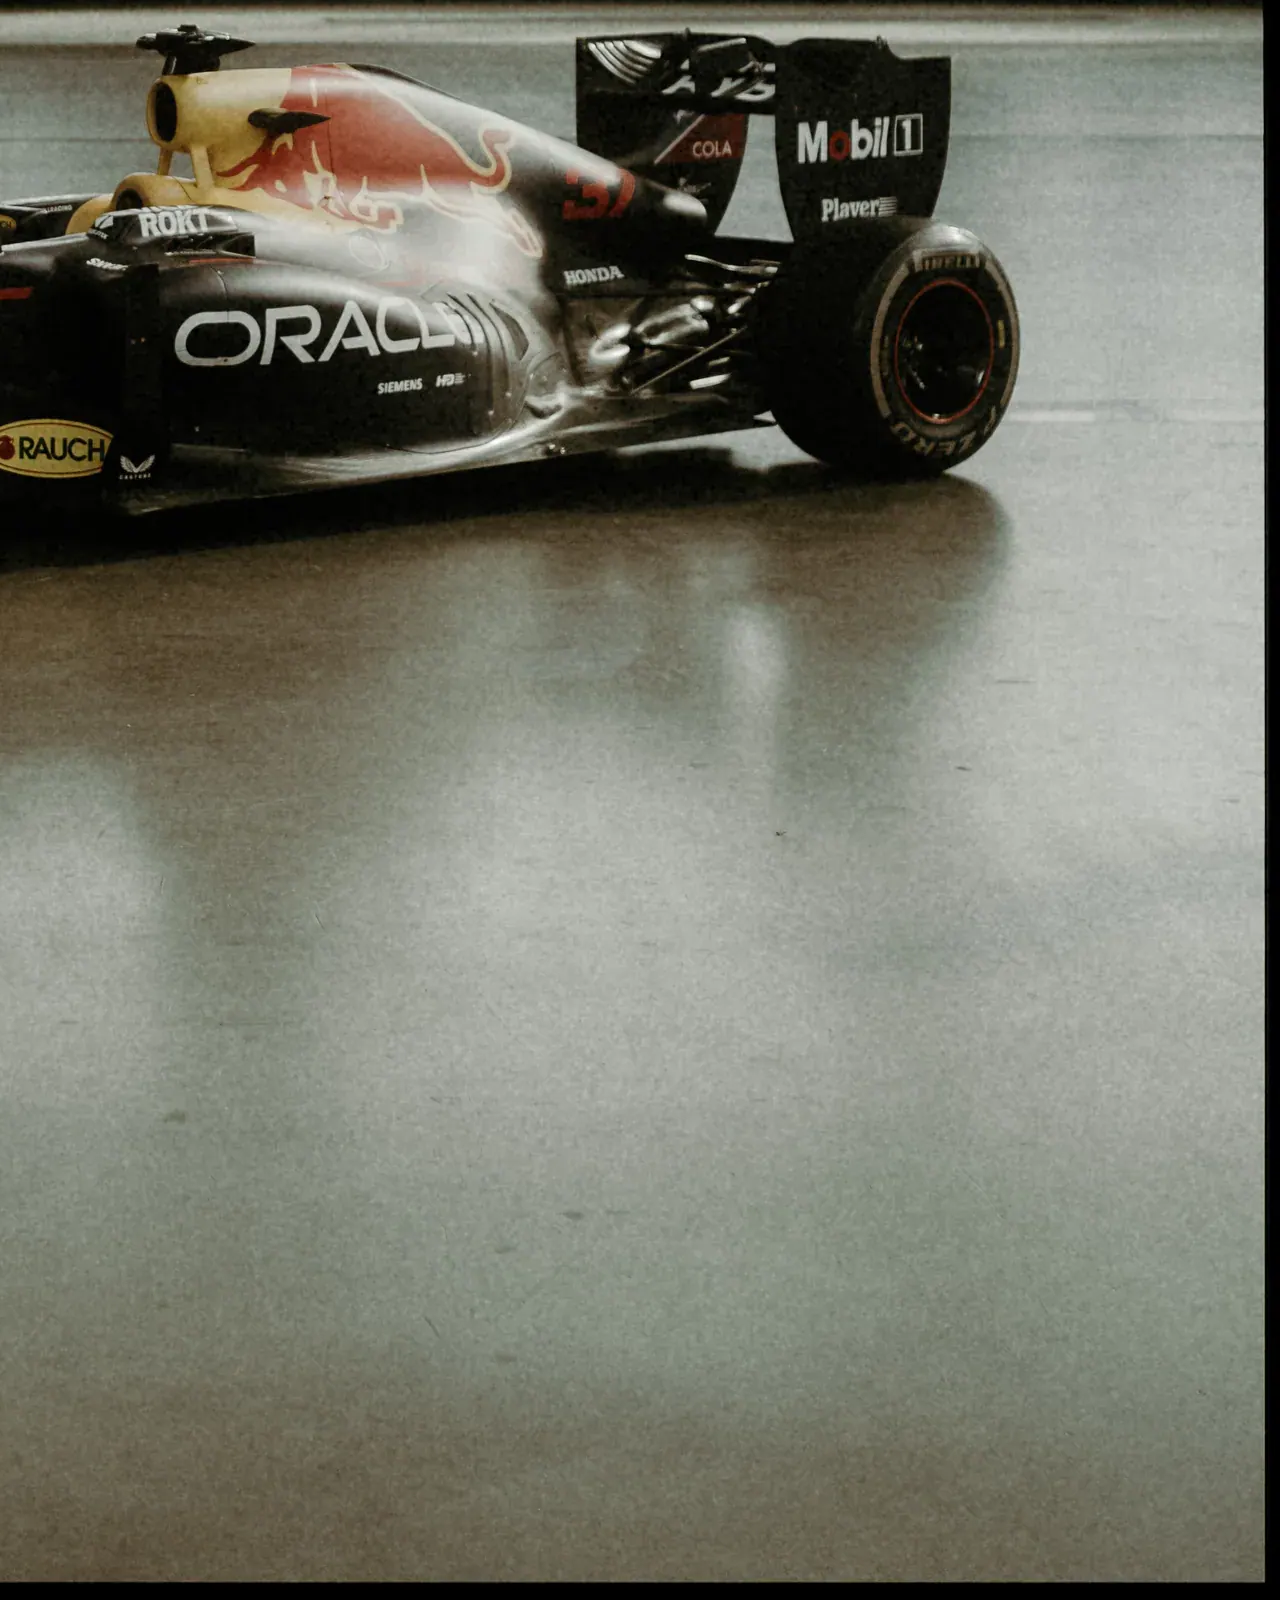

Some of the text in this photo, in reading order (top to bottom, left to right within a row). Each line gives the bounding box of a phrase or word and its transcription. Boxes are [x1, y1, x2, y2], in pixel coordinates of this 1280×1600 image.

[692, 140, 733, 159] COLA
[797, 116, 890, 164] Mobil
[138, 208, 209, 238] ROKT
[563, 265, 625, 286] HONDA
[174, 296, 487, 366] ORACLE
[377, 377, 424, 396] SIEMENS
[19, 436, 105, 462] RAUCH
